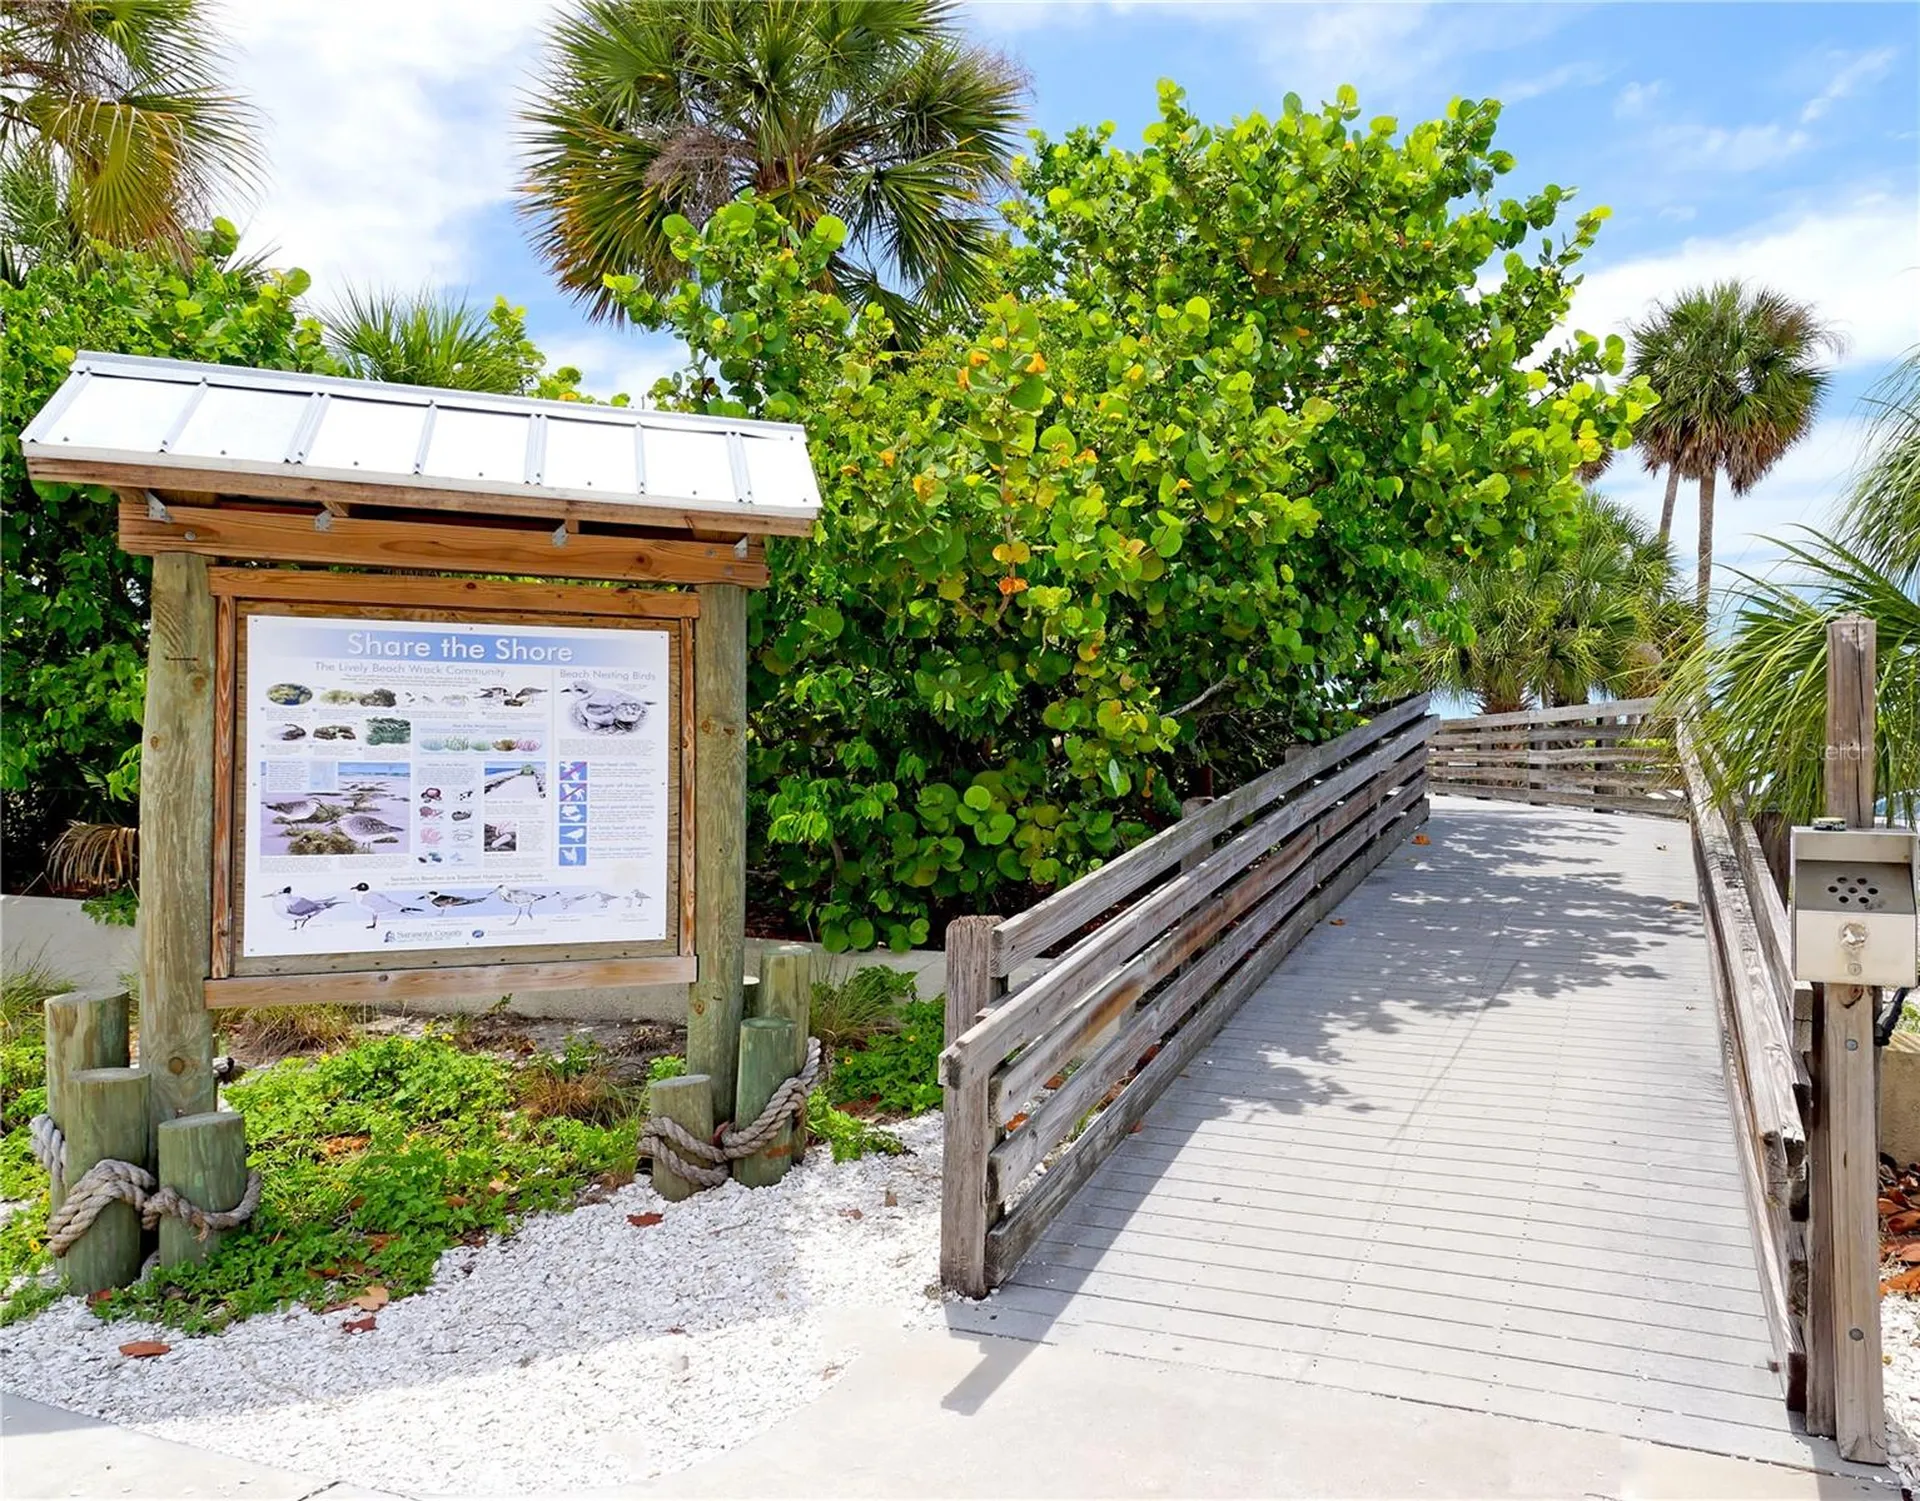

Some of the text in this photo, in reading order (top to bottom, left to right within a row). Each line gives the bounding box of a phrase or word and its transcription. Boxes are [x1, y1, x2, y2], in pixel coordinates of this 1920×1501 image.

[348, 632, 573, 662] Share the Shore
[315, 661, 505, 678] The Lively Beach Wrack Community
[560, 669, 656, 681] Beach Nesting Birds
